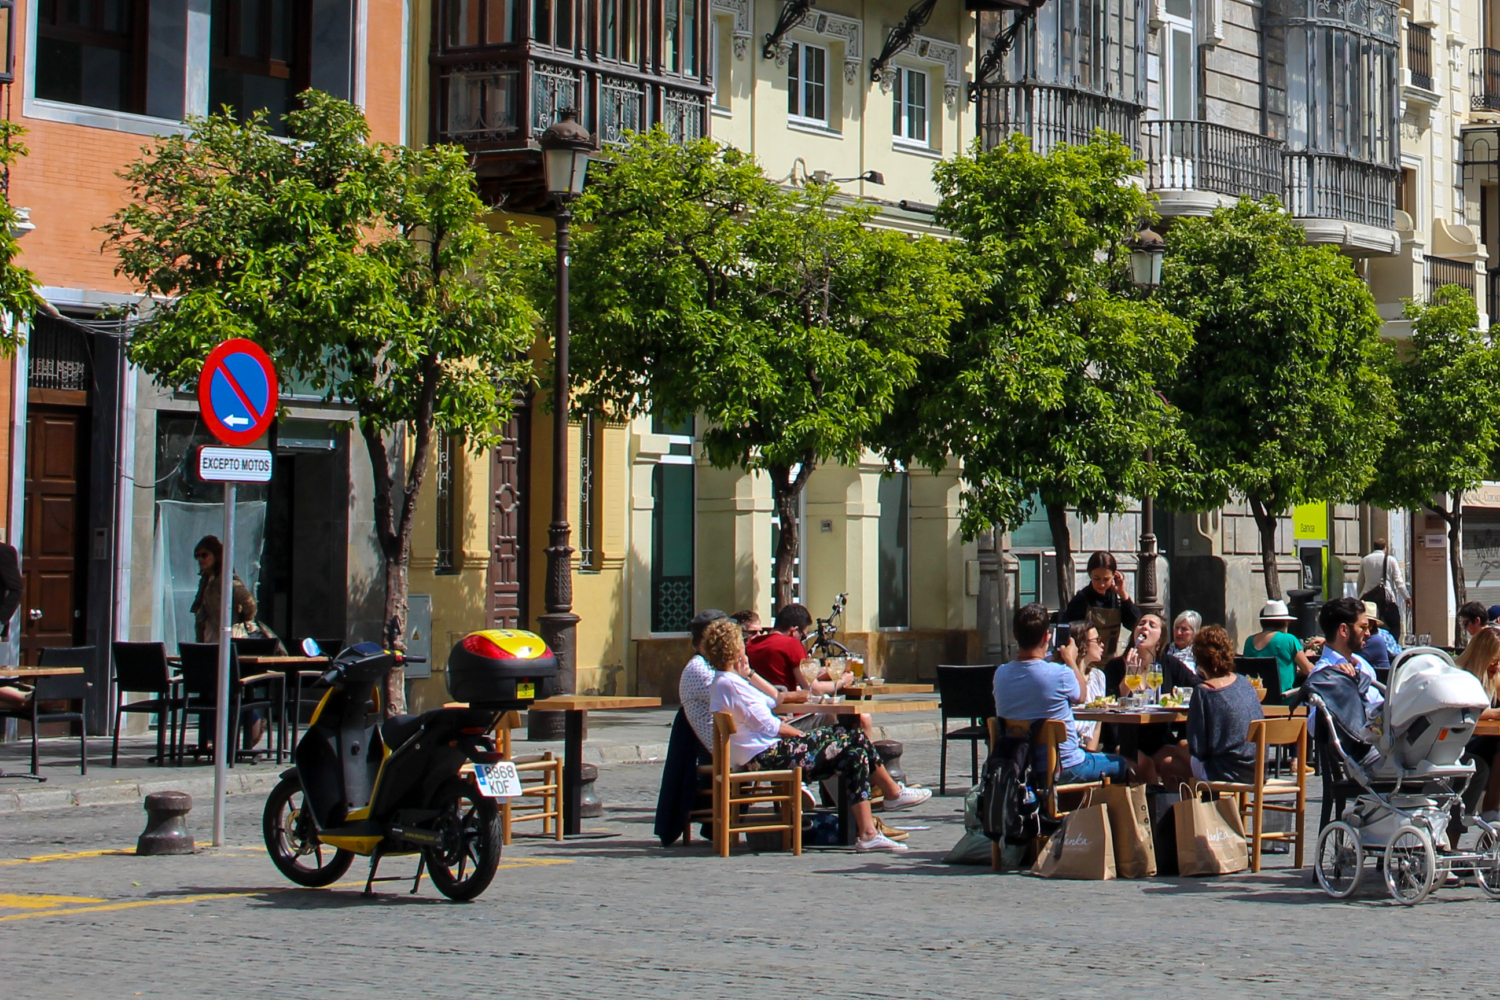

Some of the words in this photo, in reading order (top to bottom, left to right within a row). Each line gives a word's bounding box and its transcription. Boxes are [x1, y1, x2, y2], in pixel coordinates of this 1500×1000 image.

[203, 457, 240, 470] EXCEPTO
[242, 458, 270, 471] MOTOS
[485, 765, 514, 779] 8868
[489, 780, 509, 794] KDF
